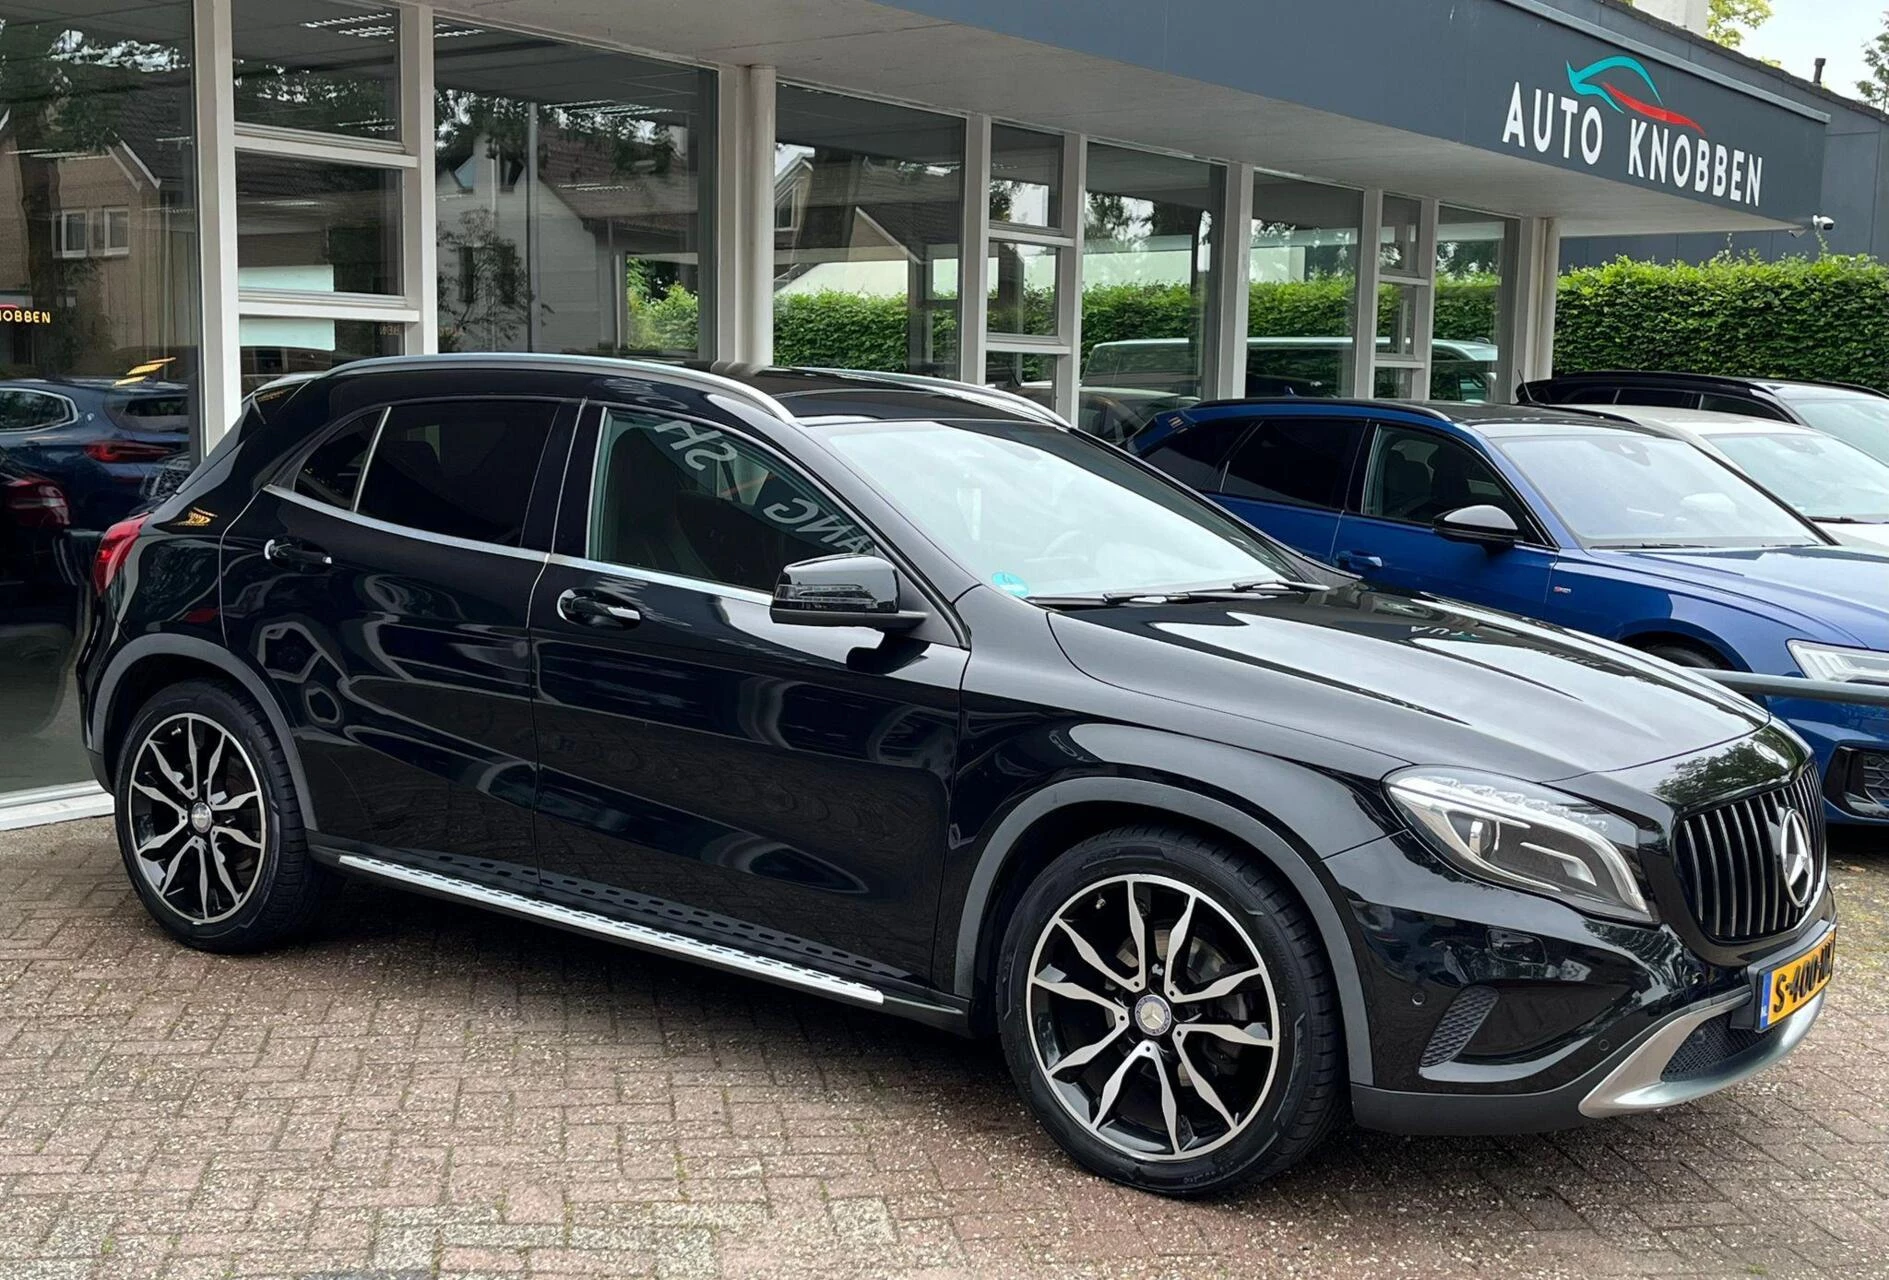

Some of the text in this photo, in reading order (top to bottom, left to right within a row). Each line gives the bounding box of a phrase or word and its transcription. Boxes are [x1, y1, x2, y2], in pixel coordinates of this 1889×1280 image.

[1502, 82, 1763, 207] AUTO KNOBBEN
[0, 310, 51, 324] OBBEN
